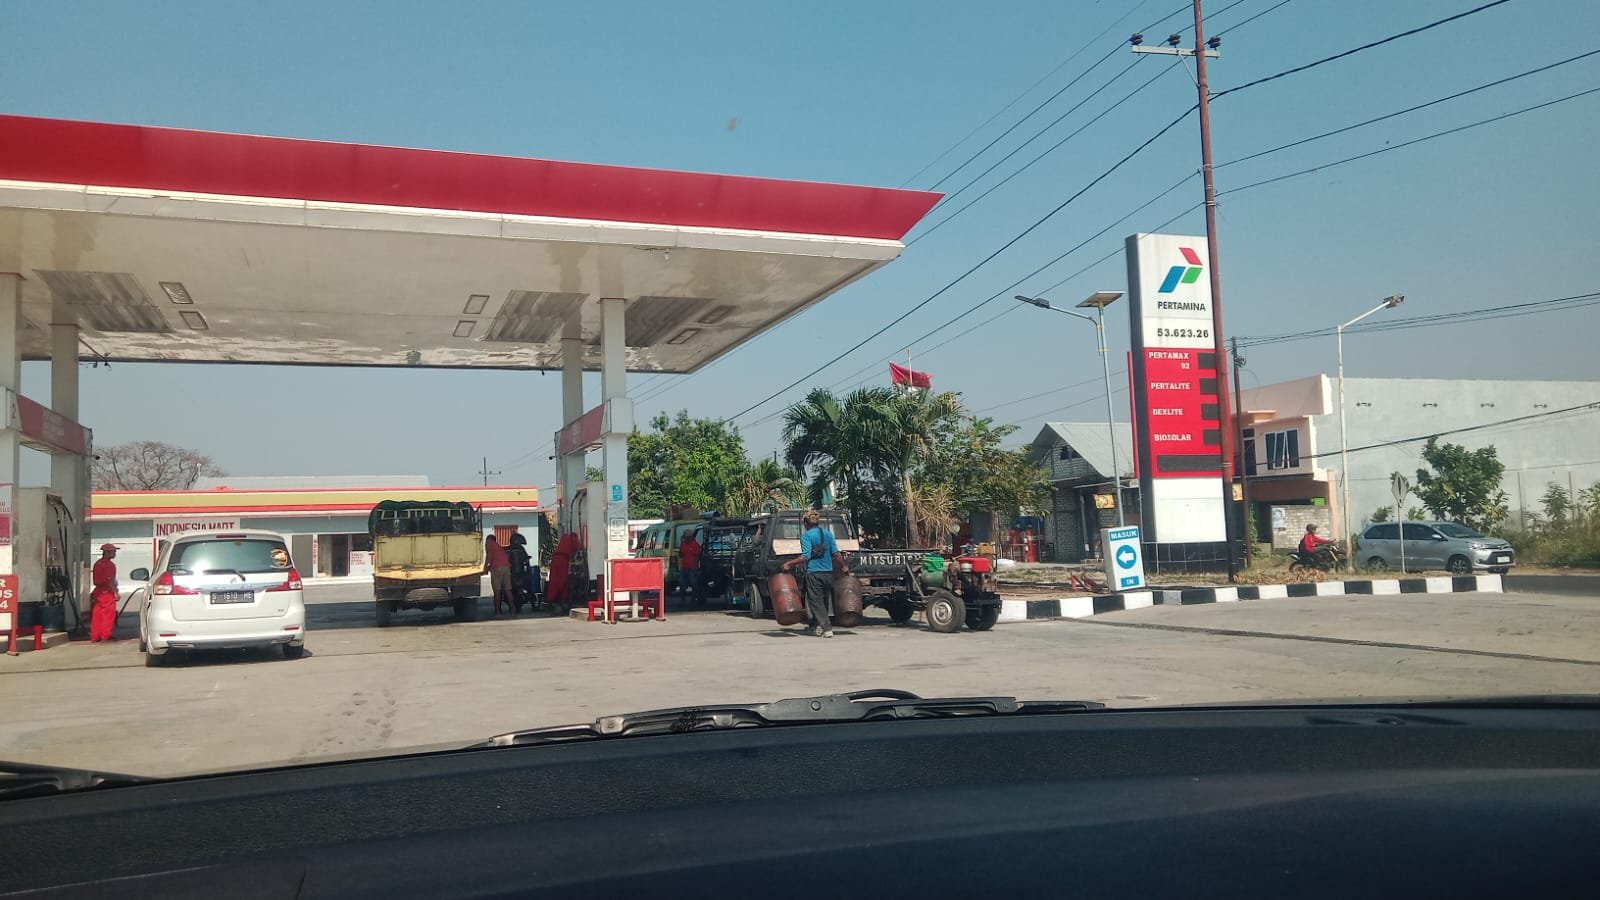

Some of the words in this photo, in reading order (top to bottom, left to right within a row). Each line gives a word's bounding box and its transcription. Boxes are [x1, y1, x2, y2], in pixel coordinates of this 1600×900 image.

[1157, 301, 1206, 311] PERTAMINA
[1157, 328, 1209, 338] 53.623.26
[1148, 351, 1189, 360] PERTAMAX
[1150, 382, 1191, 390] PERTALITE
[1152, 408, 1184, 416] DEXLITE
[1110, 530, 1137, 540] MASUK
